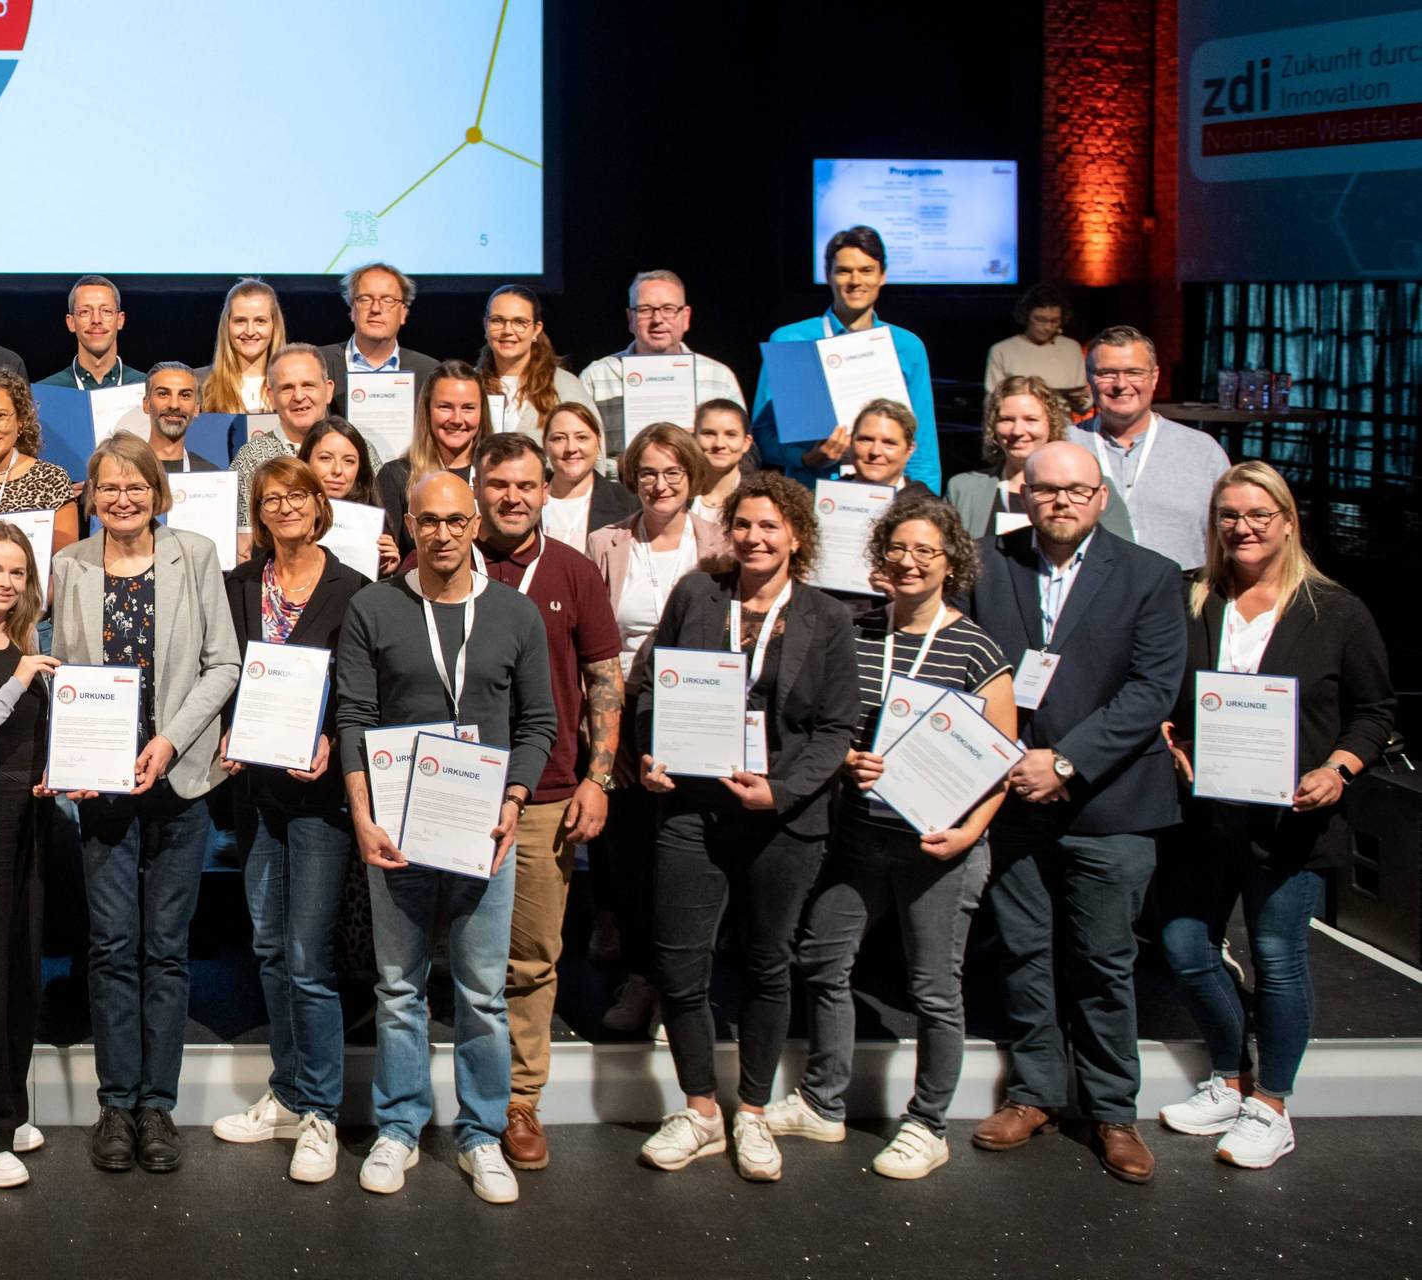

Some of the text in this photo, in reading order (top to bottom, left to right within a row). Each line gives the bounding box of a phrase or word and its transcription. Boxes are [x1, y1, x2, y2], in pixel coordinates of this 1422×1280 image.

[1281, 46, 1363, 78] Zukunft
[1202, 58, 1271, 117] zdi
[1281, 80, 1391, 109] Innovation
[889, 166, 943, 177] Programm
[480, 233, 489, 246] 5
[682, 676, 721, 686] URKUNDE
[79, 692, 115, 700] URKUNDE
[1225, 700, 1267, 710] URKUNDE
[950, 730, 983, 761] URKUNDE
[442, 767, 481, 780] URKUNDE
